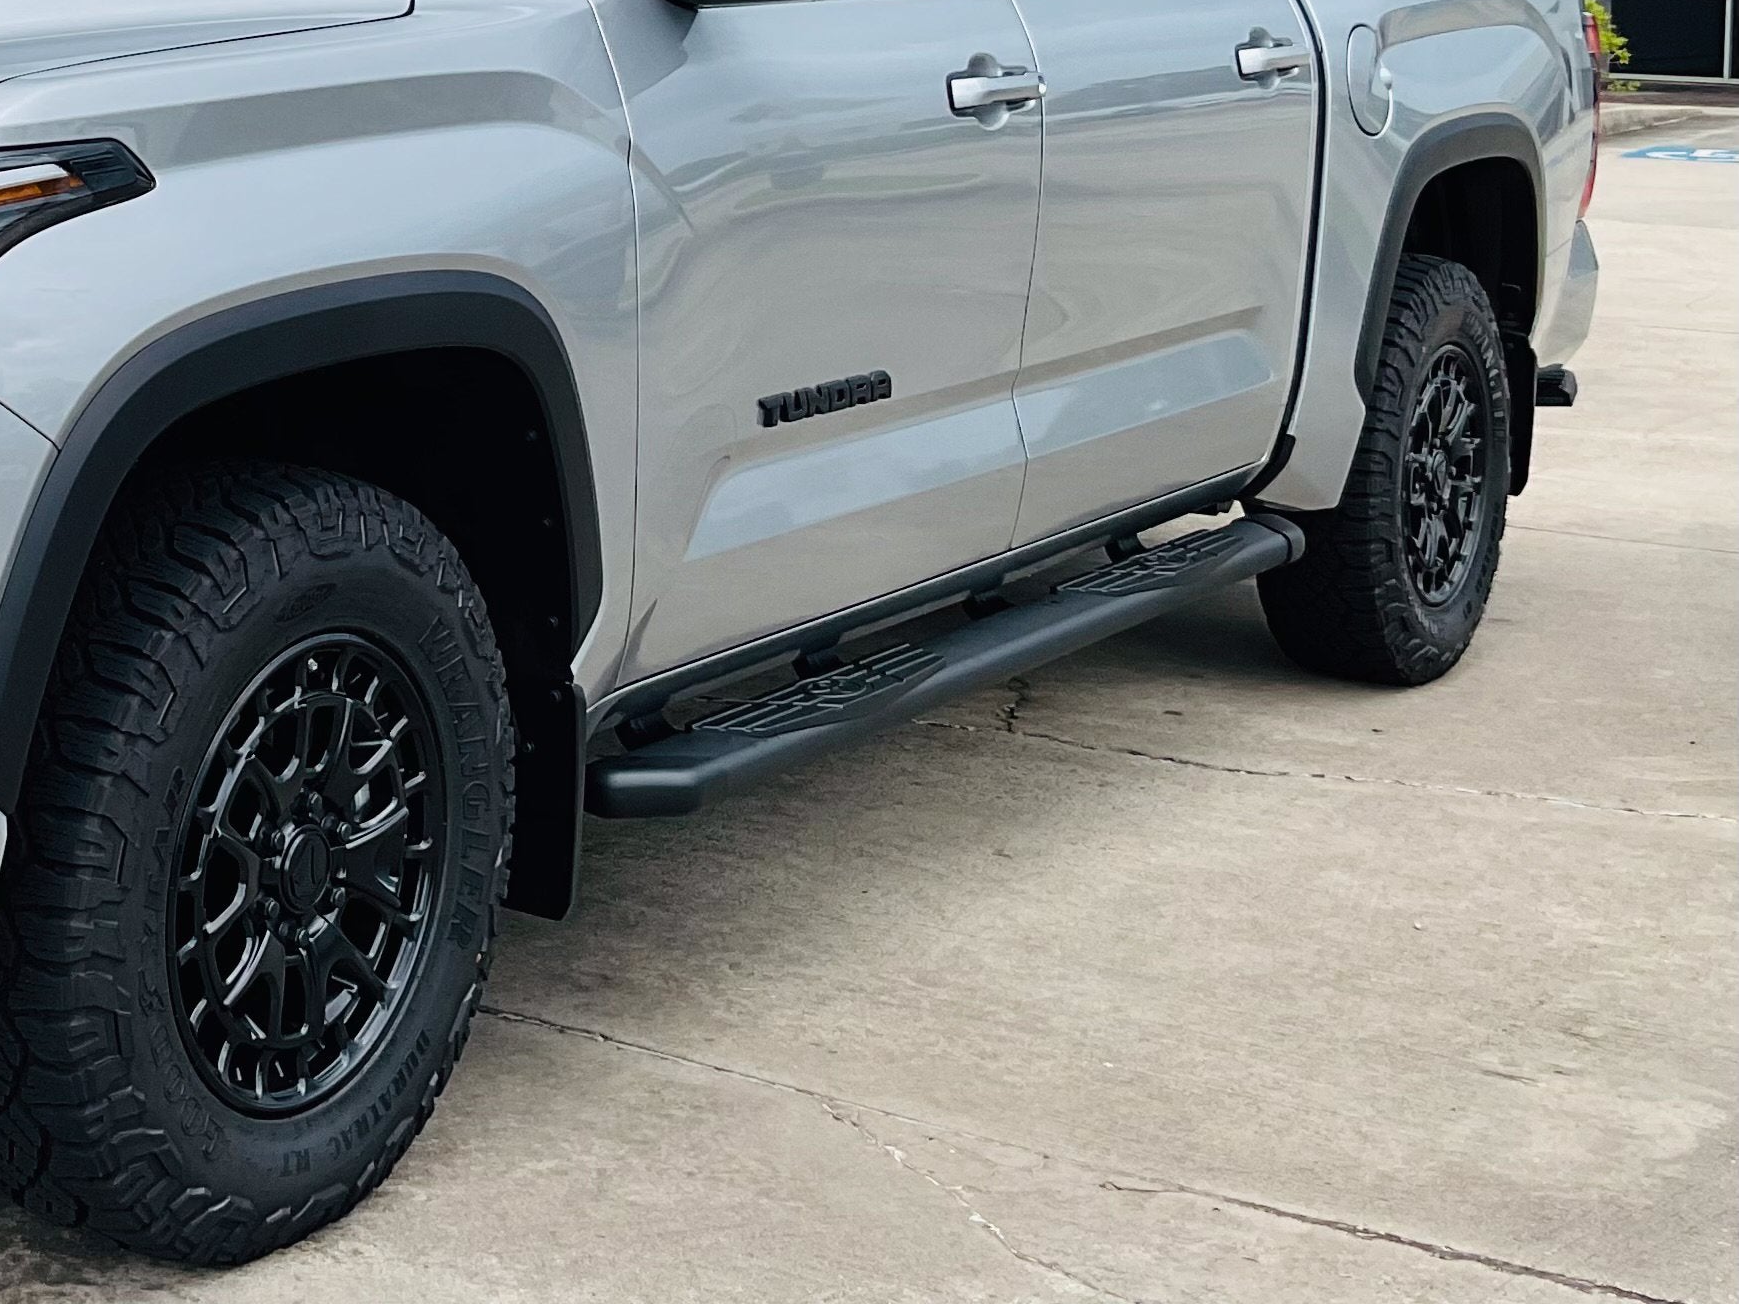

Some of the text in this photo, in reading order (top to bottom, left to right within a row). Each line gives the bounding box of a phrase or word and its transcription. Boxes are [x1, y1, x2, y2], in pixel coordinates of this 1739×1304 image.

[757, 370, 893, 428] TUNDRA
[418, 615, 492, 951] WRANGLER
[279, 1028, 431, 1178] DURATRAC RT
